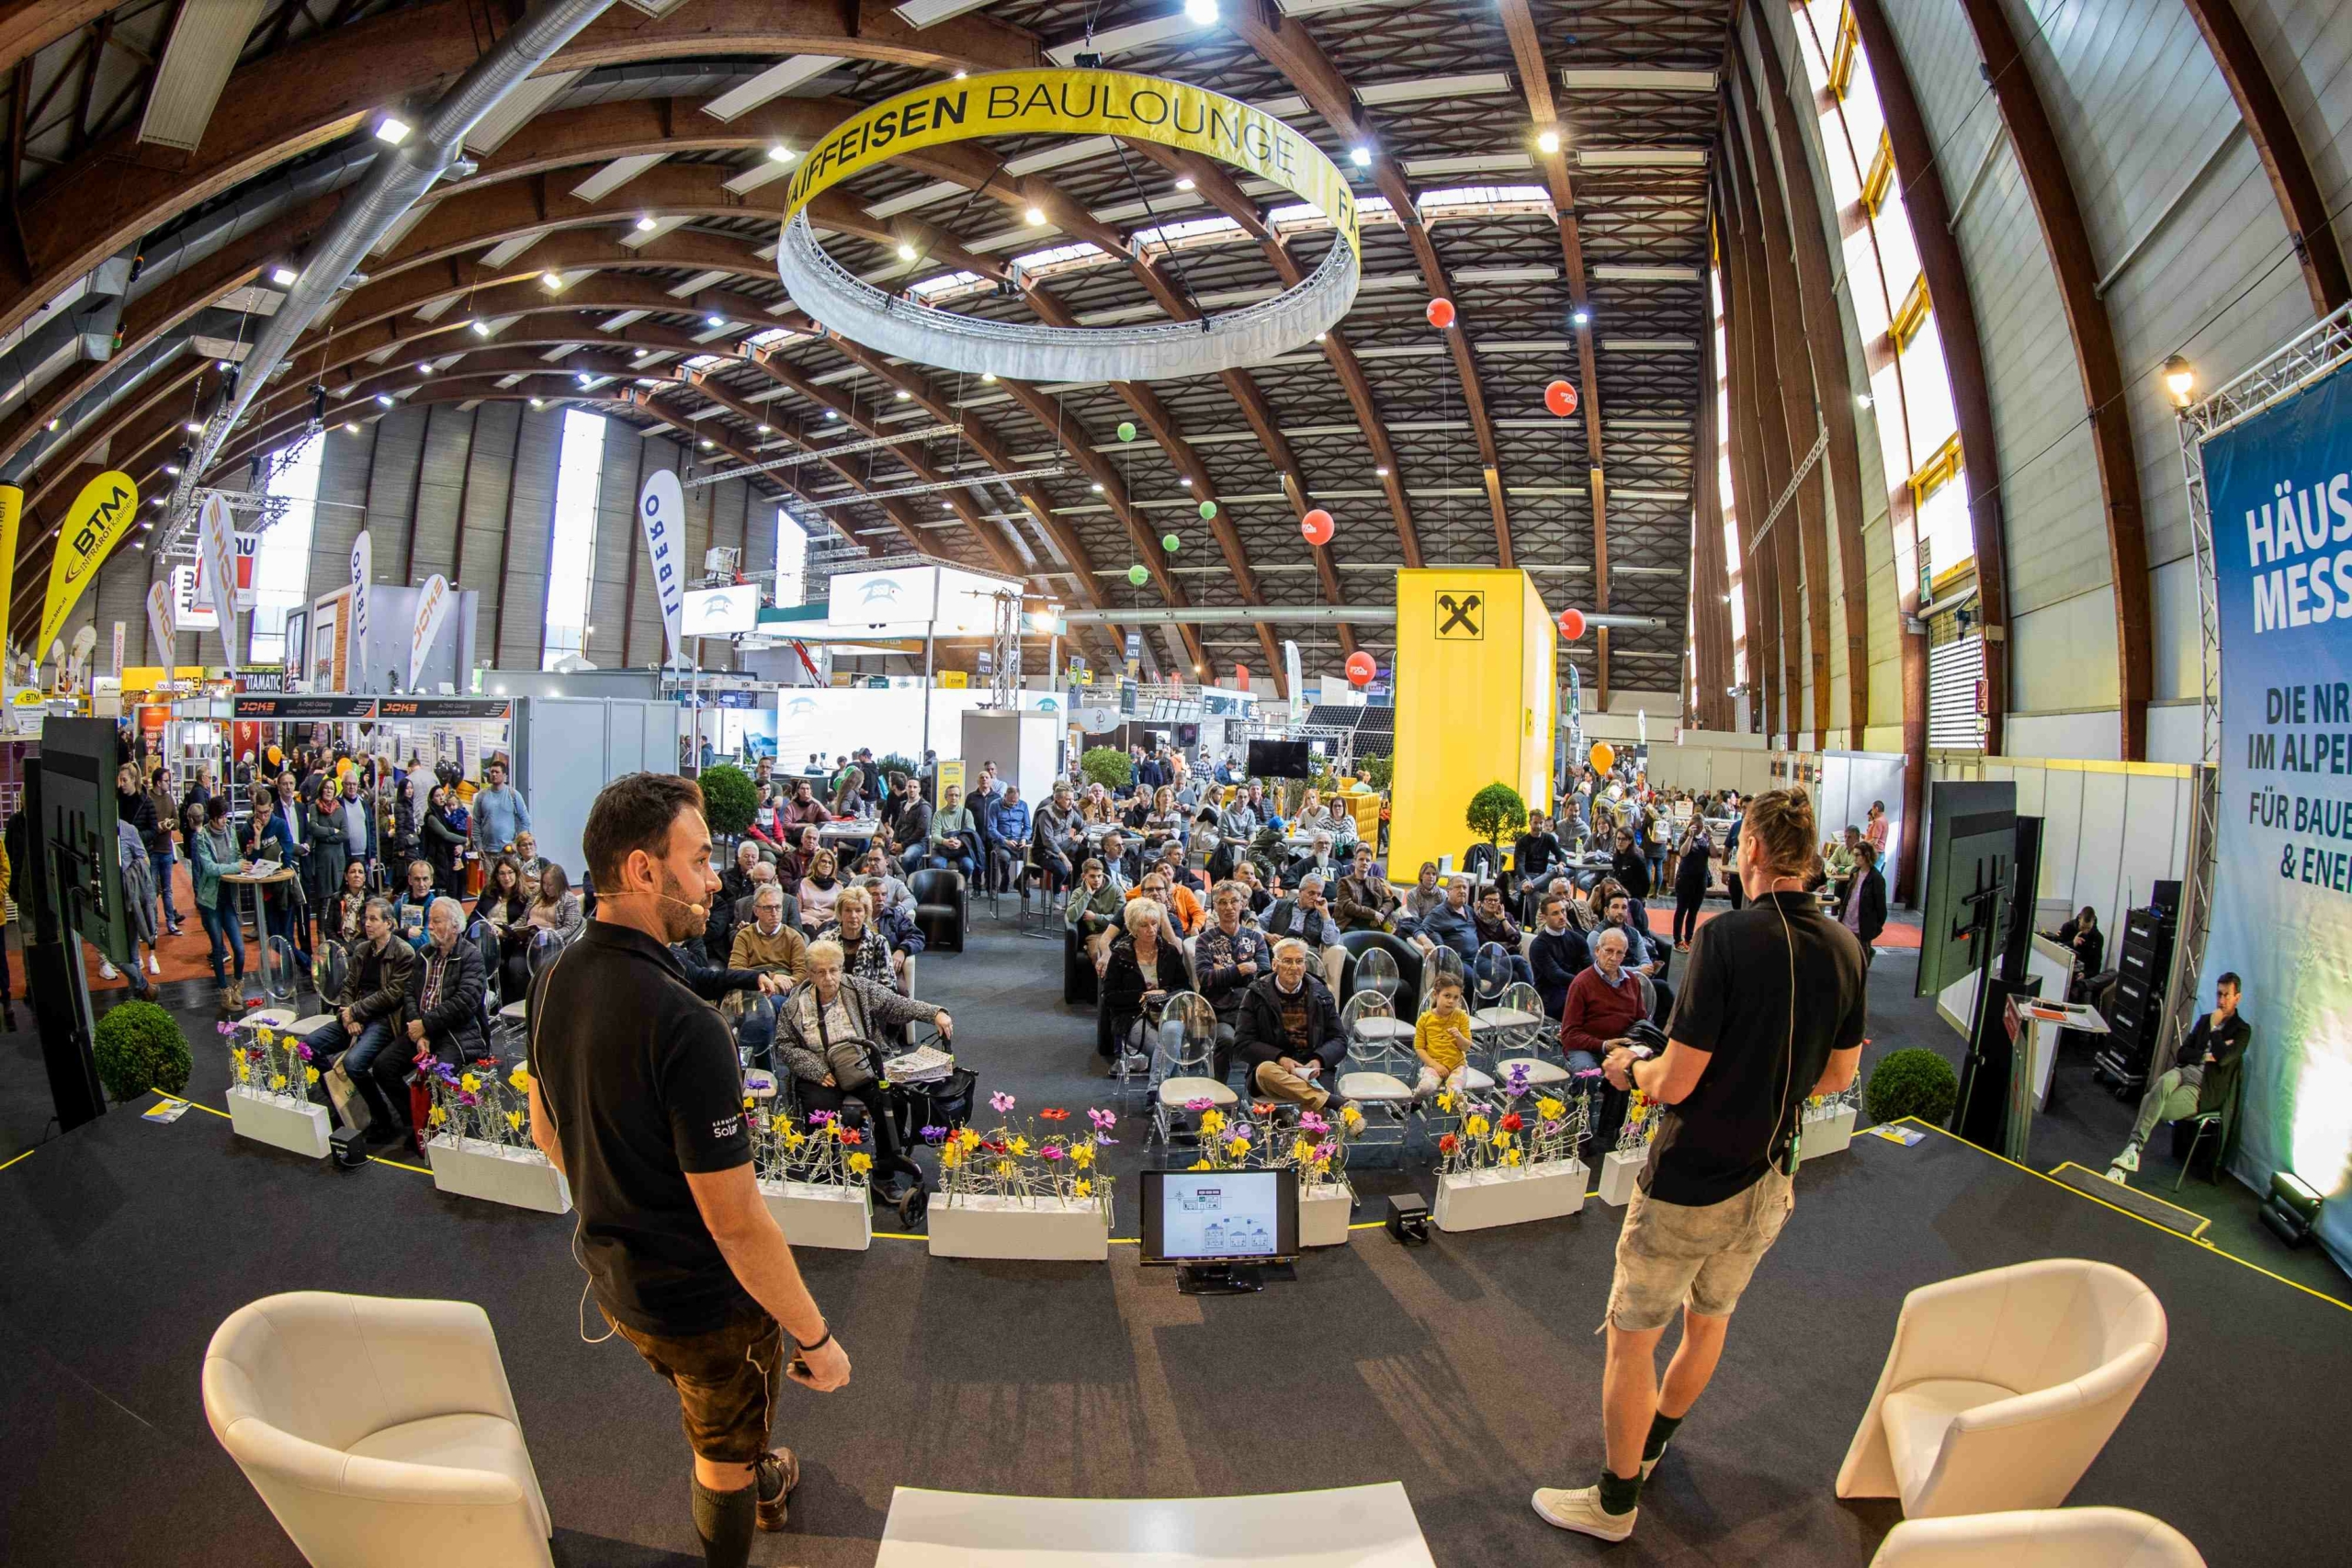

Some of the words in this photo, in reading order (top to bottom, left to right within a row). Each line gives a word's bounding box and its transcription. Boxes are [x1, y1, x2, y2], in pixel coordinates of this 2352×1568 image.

[988, 83, 1296, 175] BAULOUNGE
[73, 485, 130, 558] BTM
[2245, 473, 2352, 568] HÄUS
[2253, 549, 2352, 634] MESS
[236, 672, 281, 690] NTAMATIC
[238, 702, 277, 711] JOKE
[382, 704, 419, 712] JOKE
[2267, 684, 2306, 724] DIE
[2313, 682, 2352, 723] NR
[2247, 734, 2275, 770] IM
[2249, 785, 2289, 830] FÜR
[2294, 795, 2352, 840] BAUE
[1311, 866, 1337, 882] CAT
[2280, 843, 2296, 880] &
